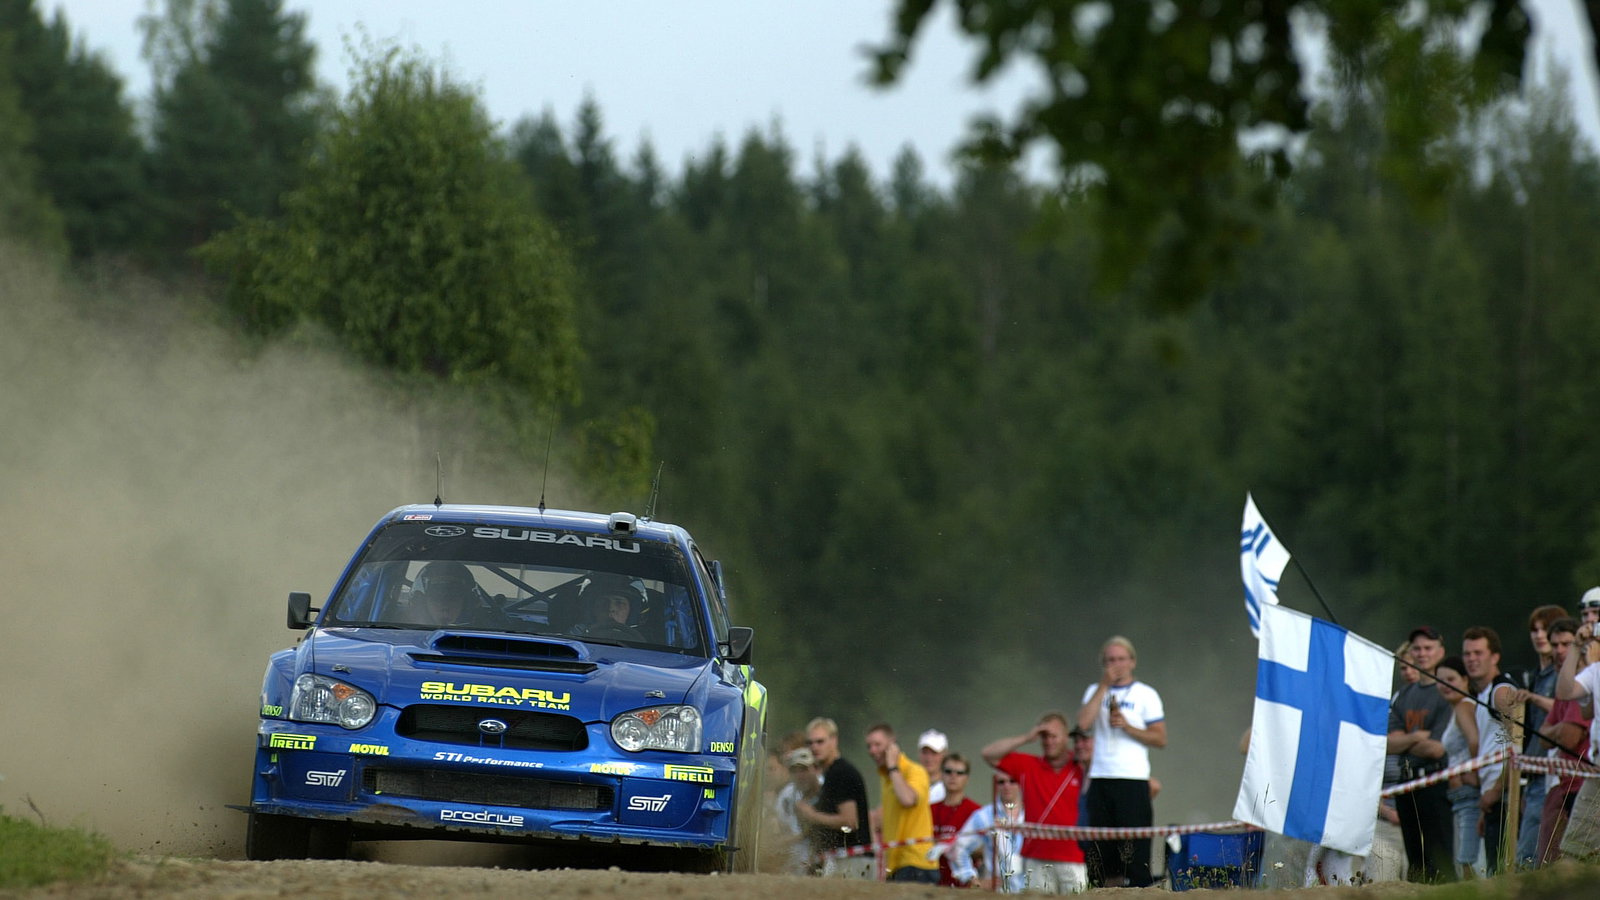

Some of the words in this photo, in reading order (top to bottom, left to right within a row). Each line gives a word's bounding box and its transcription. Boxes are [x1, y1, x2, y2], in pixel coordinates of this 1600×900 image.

[472, 527, 641, 553] SUBARU
[421, 681, 571, 704] SUBARU
[420, 693, 472, 702] WORLD
[477, 696, 524, 706] RALLY
[529, 700, 570, 711] TEAM
[270, 733, 317, 750] PIRELLI
[348, 743, 390, 756] MOTUL
[710, 742, 734, 753] DENSO
[433, 752, 463, 762] STI
[463, 756, 544, 769] Performance
[664, 764, 714, 783] PIRELLI
[440, 809, 524, 827] prodrive
